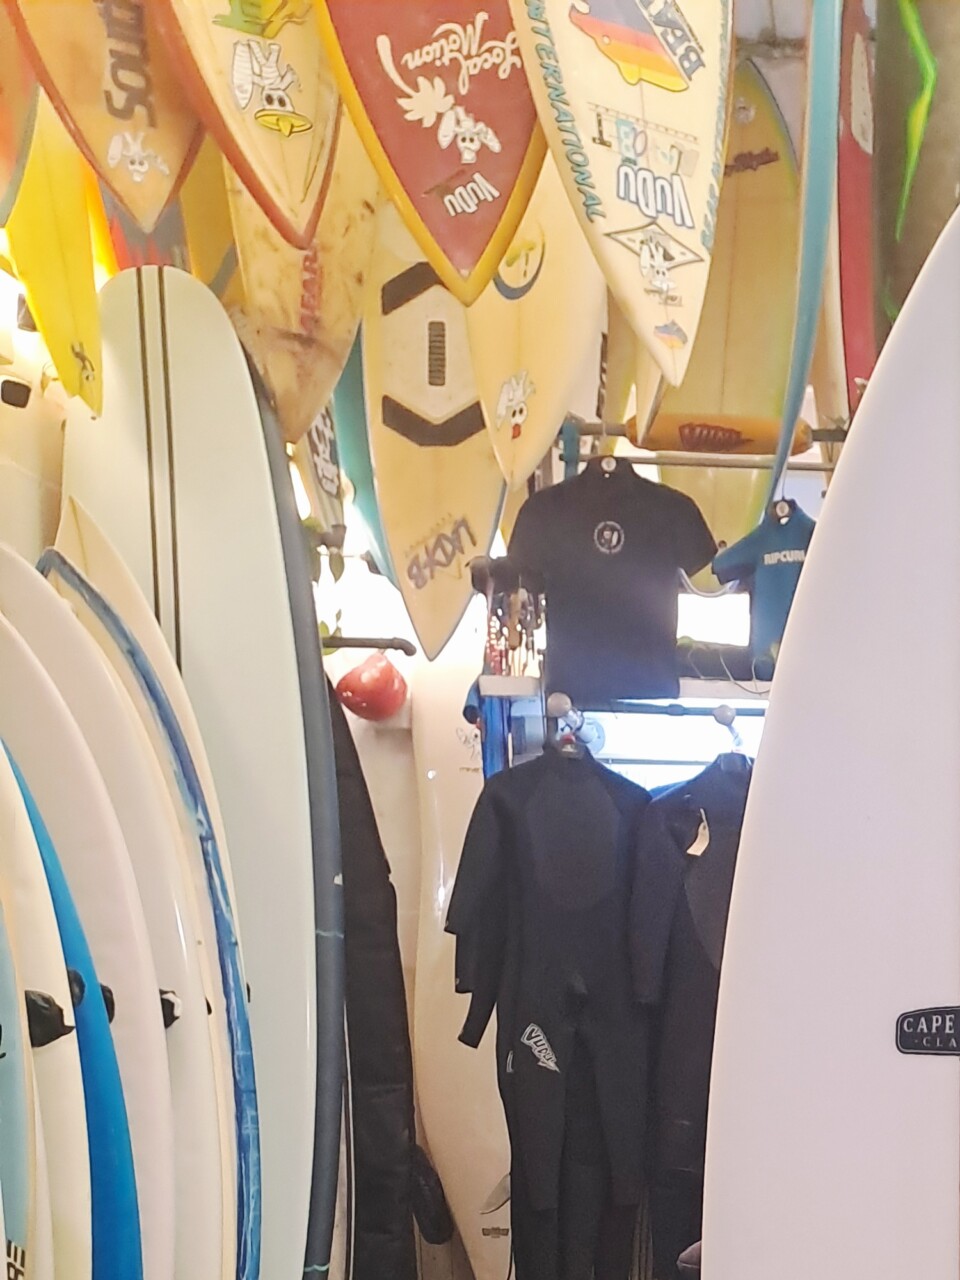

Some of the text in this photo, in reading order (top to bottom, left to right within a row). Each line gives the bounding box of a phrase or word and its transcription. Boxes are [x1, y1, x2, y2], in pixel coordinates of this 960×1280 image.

[401, 12, 489, 70] Motion
[450, 32, 522, 95] Local
[642, 0, 706, 82] BEA
[525, 0, 606, 223] NTERNATIONAL
[903, 1014, 955, 1034] CAPE
